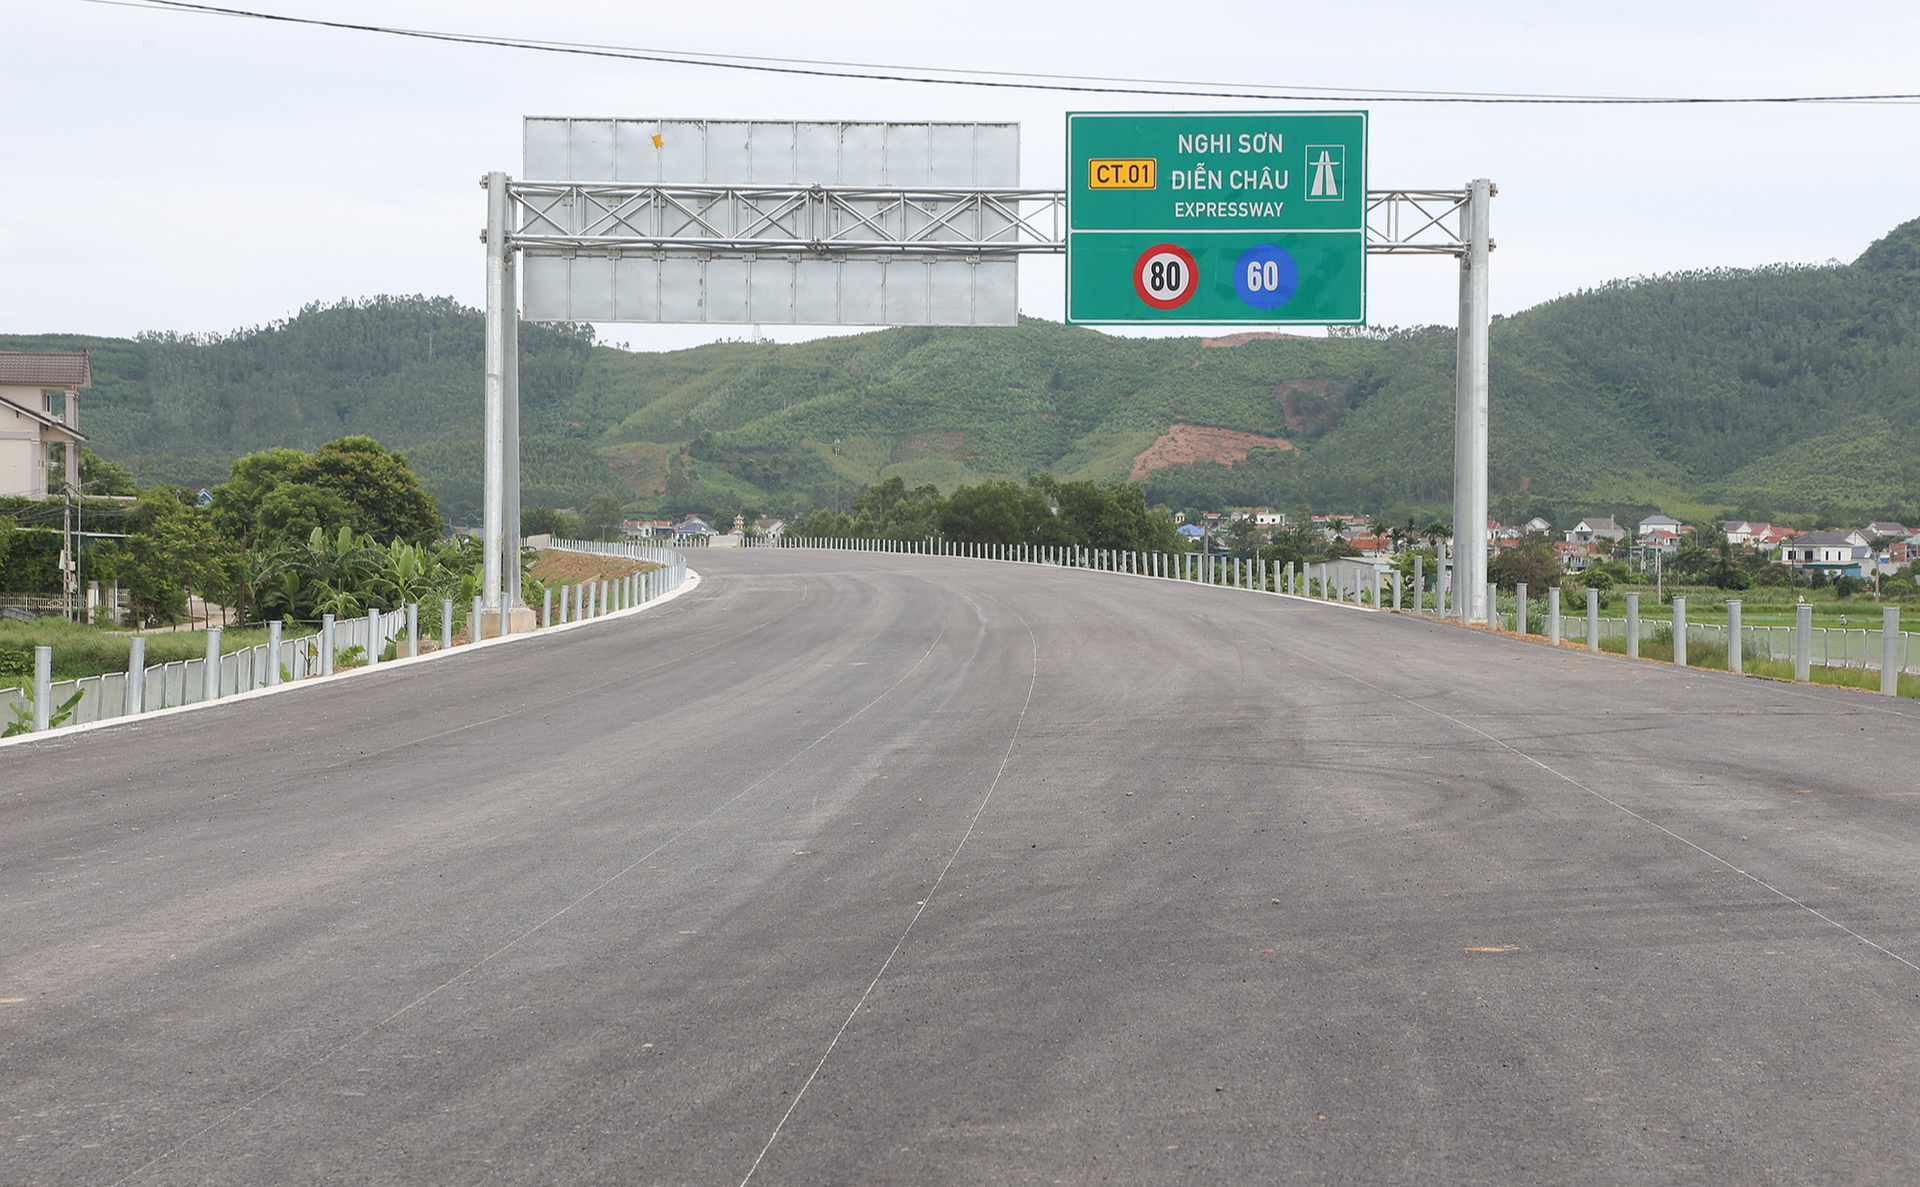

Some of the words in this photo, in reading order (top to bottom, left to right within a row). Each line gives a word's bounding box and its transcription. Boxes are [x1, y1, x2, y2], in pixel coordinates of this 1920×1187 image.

[1178, 134, 1231, 154] NGHI
[1238, 132, 1283, 154] SƠN
[1096, 164, 1149, 184] CT.01
[1171, 162, 1222, 190] DIỄN
[1229, 166, 1289, 190] CHÂU
[1174, 202, 1284, 217] EXPRESSWAY
[1150, 261, 1180, 291] 80
[1247, 261, 1278, 291] 60
